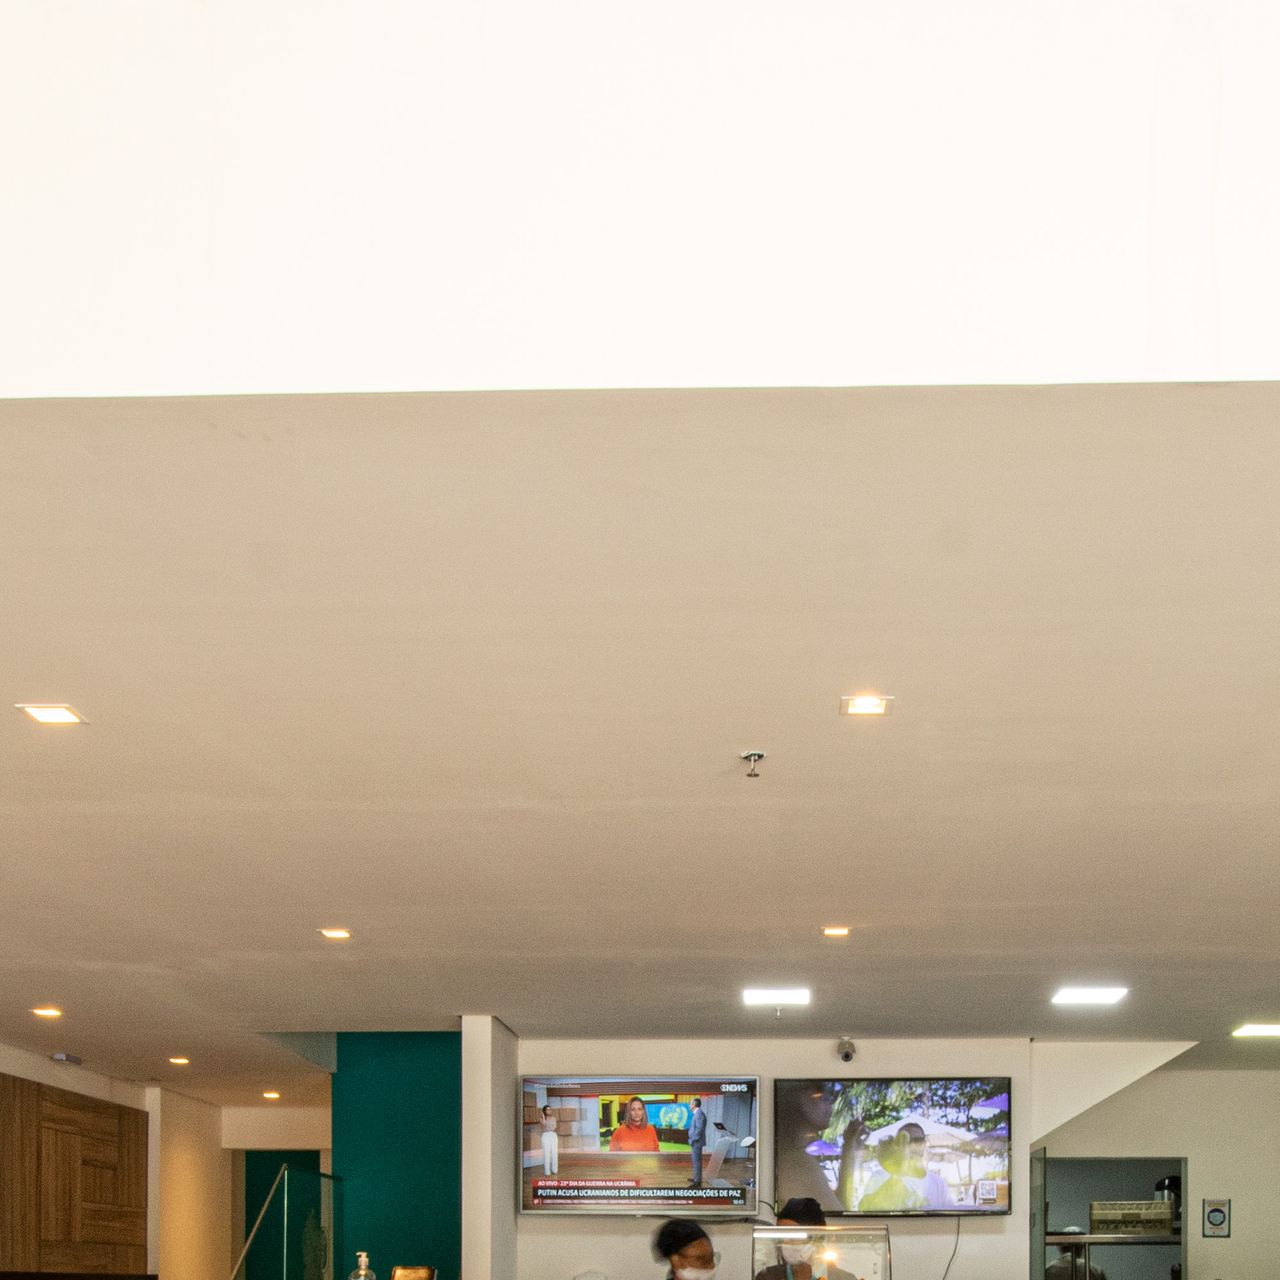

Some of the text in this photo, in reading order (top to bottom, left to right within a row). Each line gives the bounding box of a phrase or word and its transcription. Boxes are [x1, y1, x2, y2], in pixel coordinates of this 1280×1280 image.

[537, 1188, 742, 1198] PUTIN ACUSA UCRANIANOS DE DIFICULTAREM NEGOCIAÇÕES DE PAZ
